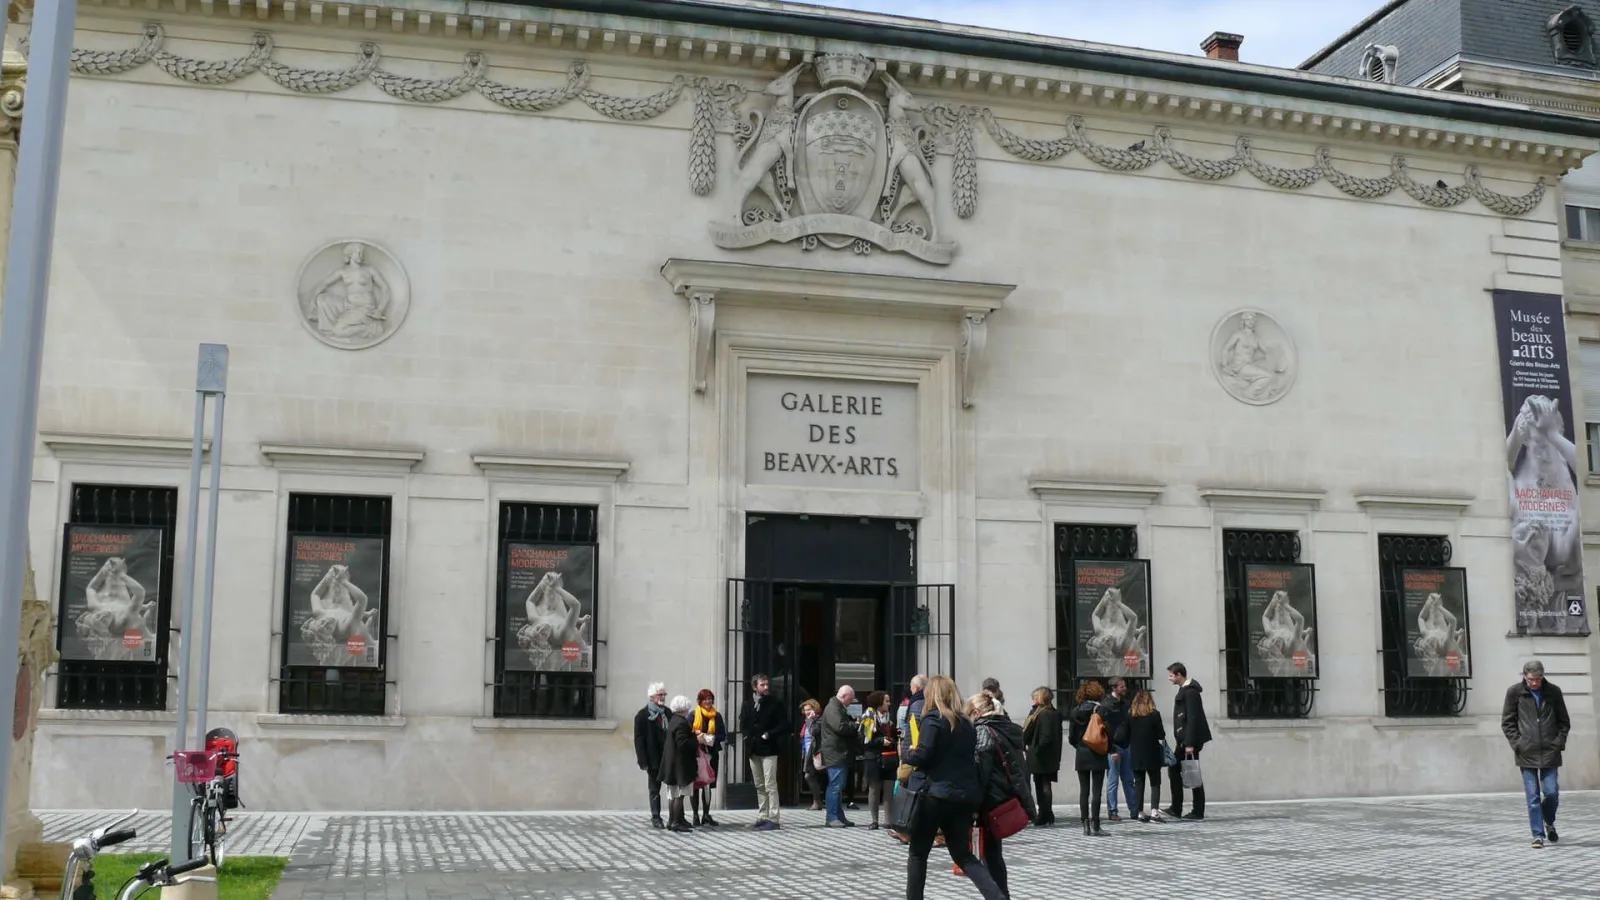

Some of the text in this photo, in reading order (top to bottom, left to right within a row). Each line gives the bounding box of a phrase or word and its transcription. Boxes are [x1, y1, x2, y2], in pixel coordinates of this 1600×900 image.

[800, 235, 818, 251] 19
[854, 239, 871, 255] 38
[1510, 309, 1550, 324] Musée
[1511, 328, 1553, 344] beaux
[1530, 325, 1543, 333] des
[780, 392, 883, 416] GALERIE
[808, 424, 857, 445] DES
[1514, 487, 1573, 501] BACCHANALES
[1518, 500, 1566, 512] MODERNES
[511, 549, 568, 560] BACCHANALES
[511, 558, 556, 569] MODERNES
